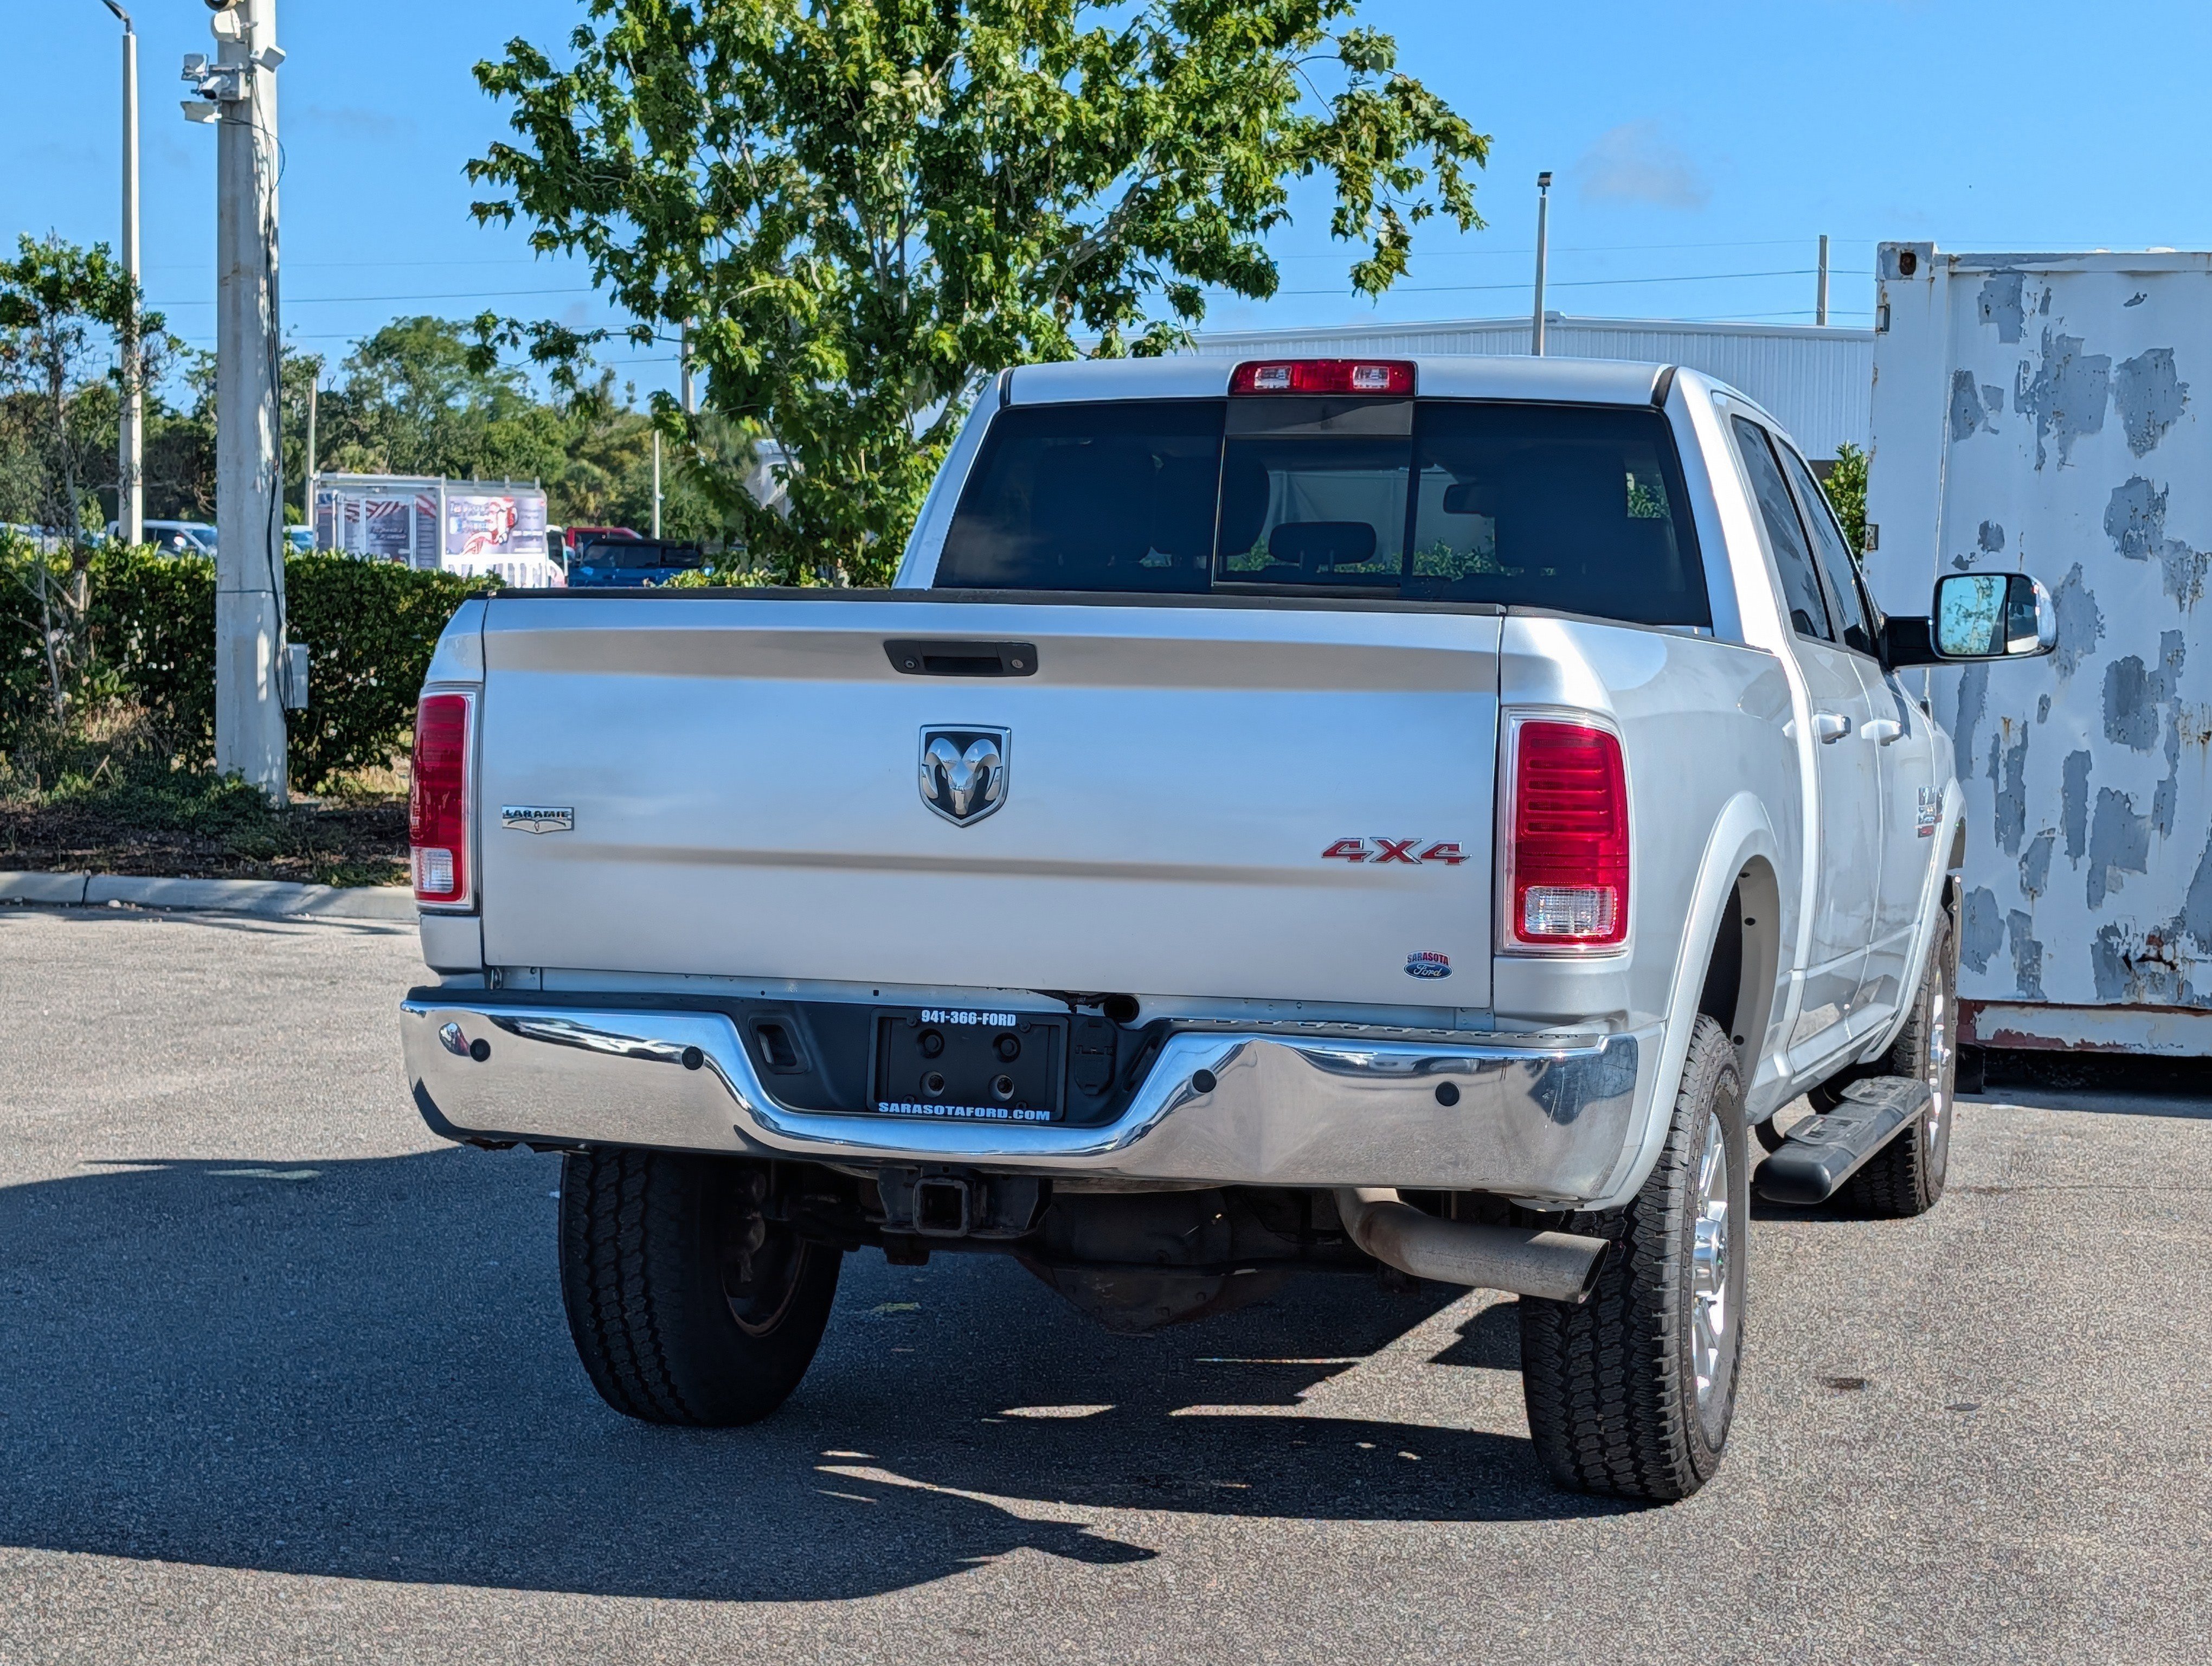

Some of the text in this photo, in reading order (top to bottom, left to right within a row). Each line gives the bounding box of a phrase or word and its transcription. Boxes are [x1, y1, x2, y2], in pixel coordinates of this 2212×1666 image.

[504, 810, 570, 818] LARAMIE
[1321, 837, 1472, 866] 4X4
[1407, 952, 1449, 965] SARASOTA
[1413, 964, 1442, 977] Ford
[922, 1010, 1016, 1026] 941-366-FORD
[878, 1103, 1050, 1120] SARASOTAFORD.COM
